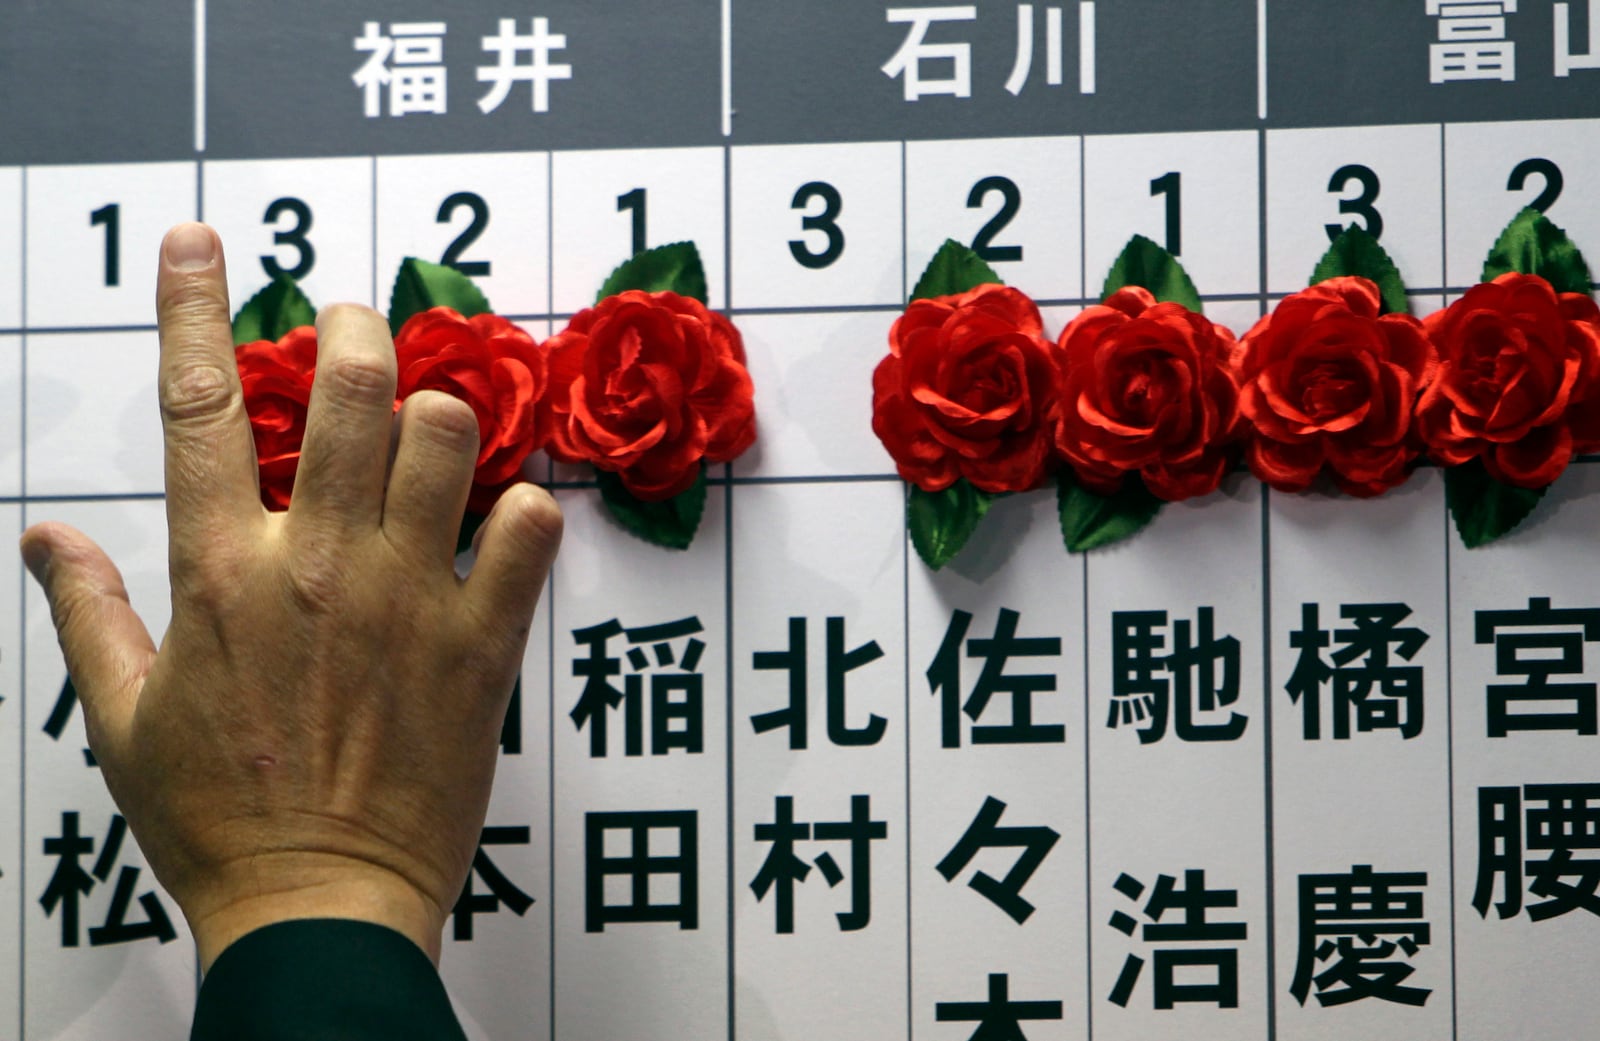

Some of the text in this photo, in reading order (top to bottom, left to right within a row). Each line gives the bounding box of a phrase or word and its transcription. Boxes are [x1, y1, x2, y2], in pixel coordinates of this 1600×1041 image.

[351, 16, 573, 118] 福井
[880, 0, 1096, 101] 石川
[617, 188, 647, 257] 1
[789, 182, 844, 268] 3
[965, 176, 1023, 261] 2
[1149, 172, 1181, 257] 1
[1325, 164, 1383, 244] 3
[1507, 158, 1564, 215] 2
[91, 203, 119, 286] 1
[260, 197, 315, 281] 3
[436, 192, 491, 276] 2
[570, 615, 706, 934] 稲田
[750, 617, 888, 933] 北村
[1472, 597, 1600, 923] 宮腰
[39, 673, 178, 947] 松
[1106, 606, 1248, 1010] 馳浩
[1285, 602, 1432, 1007] 橘慶
